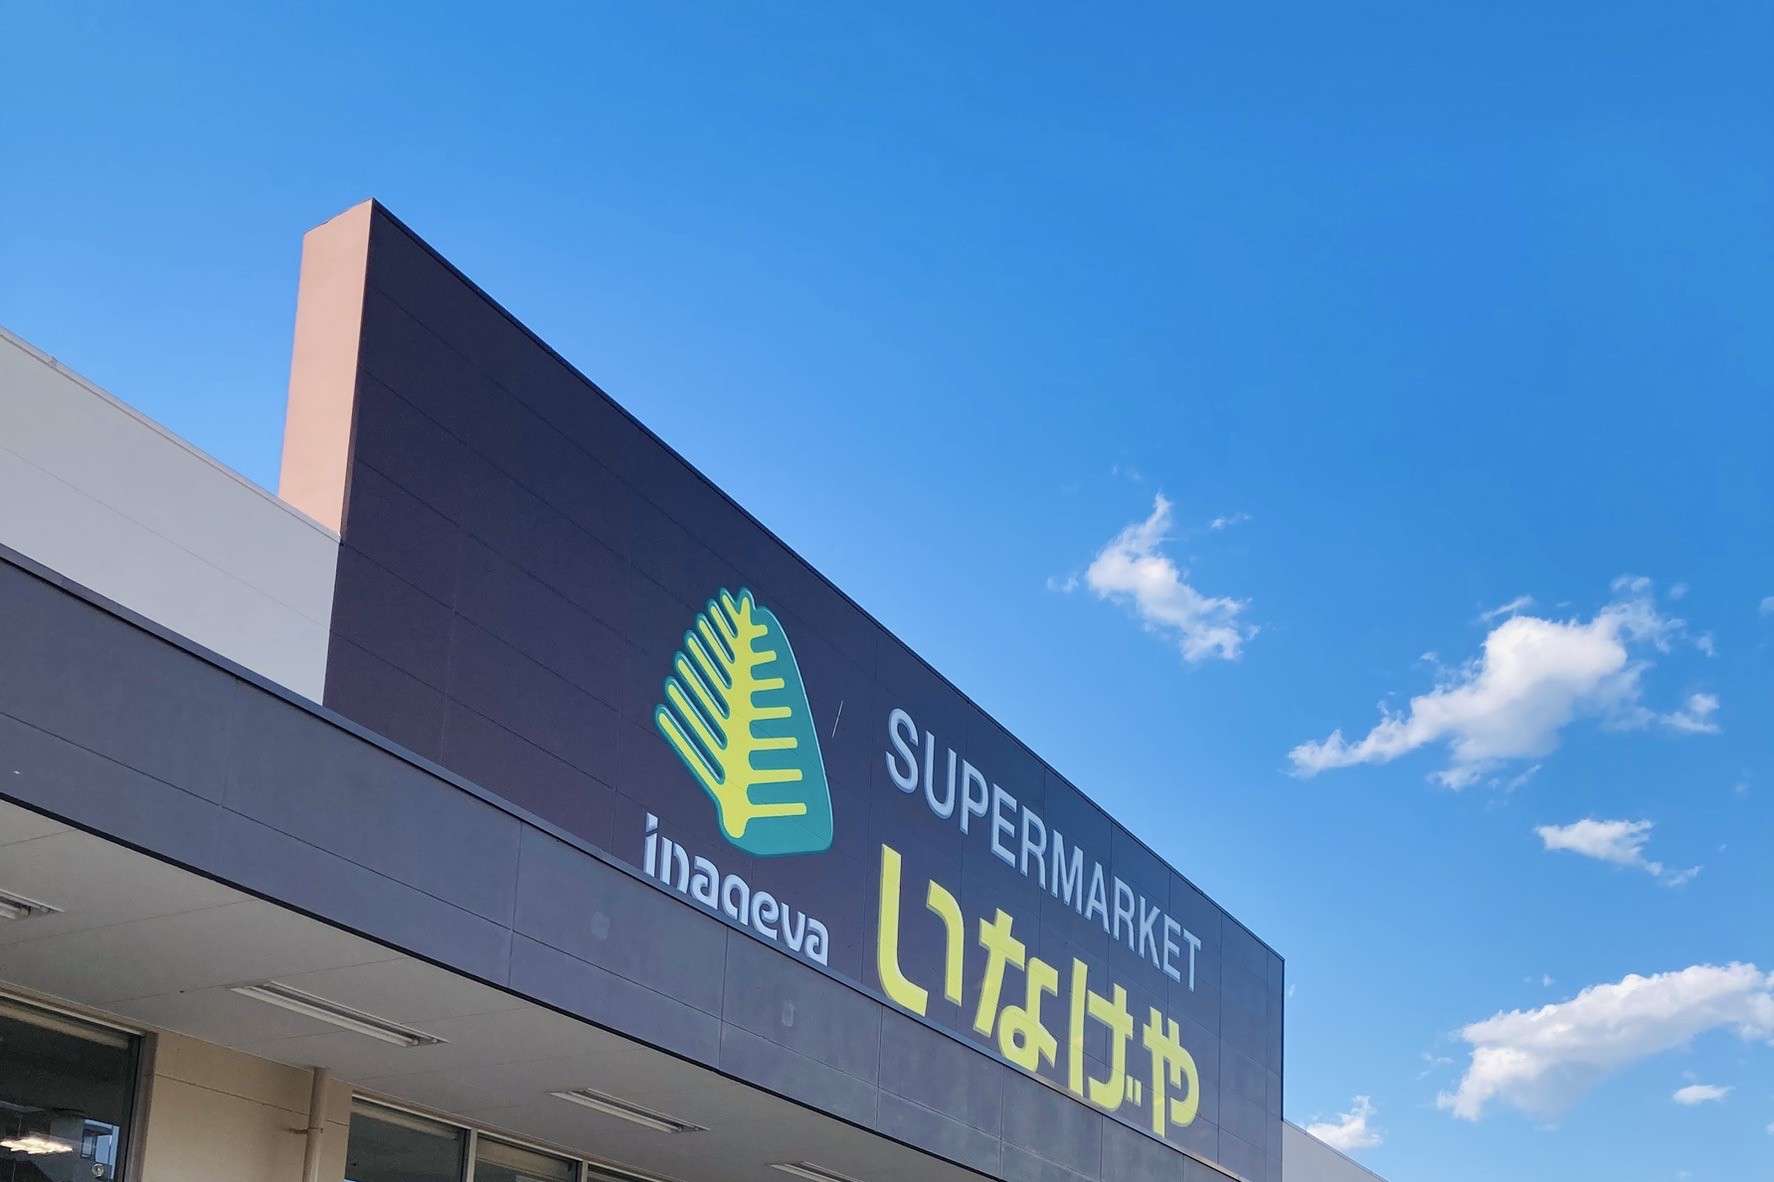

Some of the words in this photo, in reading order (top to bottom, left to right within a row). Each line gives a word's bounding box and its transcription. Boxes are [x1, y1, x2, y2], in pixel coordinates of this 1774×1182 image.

[877, 843, 1200, 1138] いなげや
[886, 708, 1202, 992] SUPERMARKET
